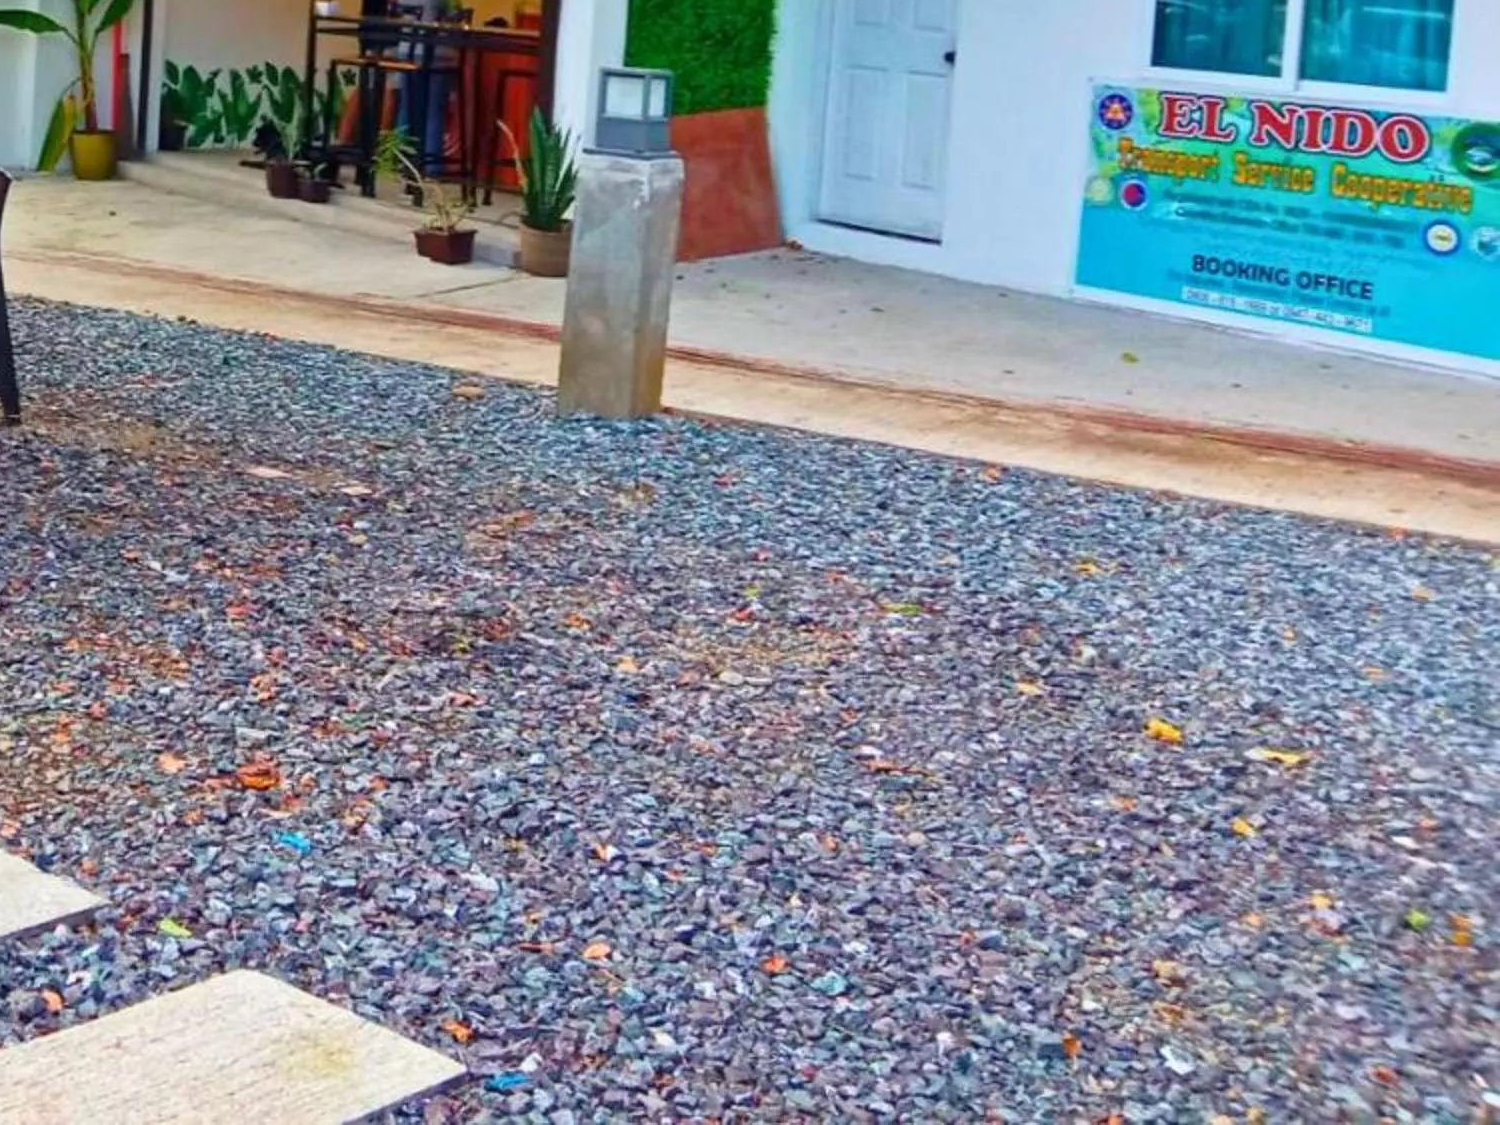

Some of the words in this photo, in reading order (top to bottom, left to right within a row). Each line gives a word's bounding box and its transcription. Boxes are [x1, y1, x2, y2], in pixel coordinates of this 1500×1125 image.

[1159, 92, 1236, 143] EL
[1250, 101, 1431, 162] NIDO
[1192, 254, 1290, 286] BOOKING
[1296, 270, 1374, 300] OFFICE
